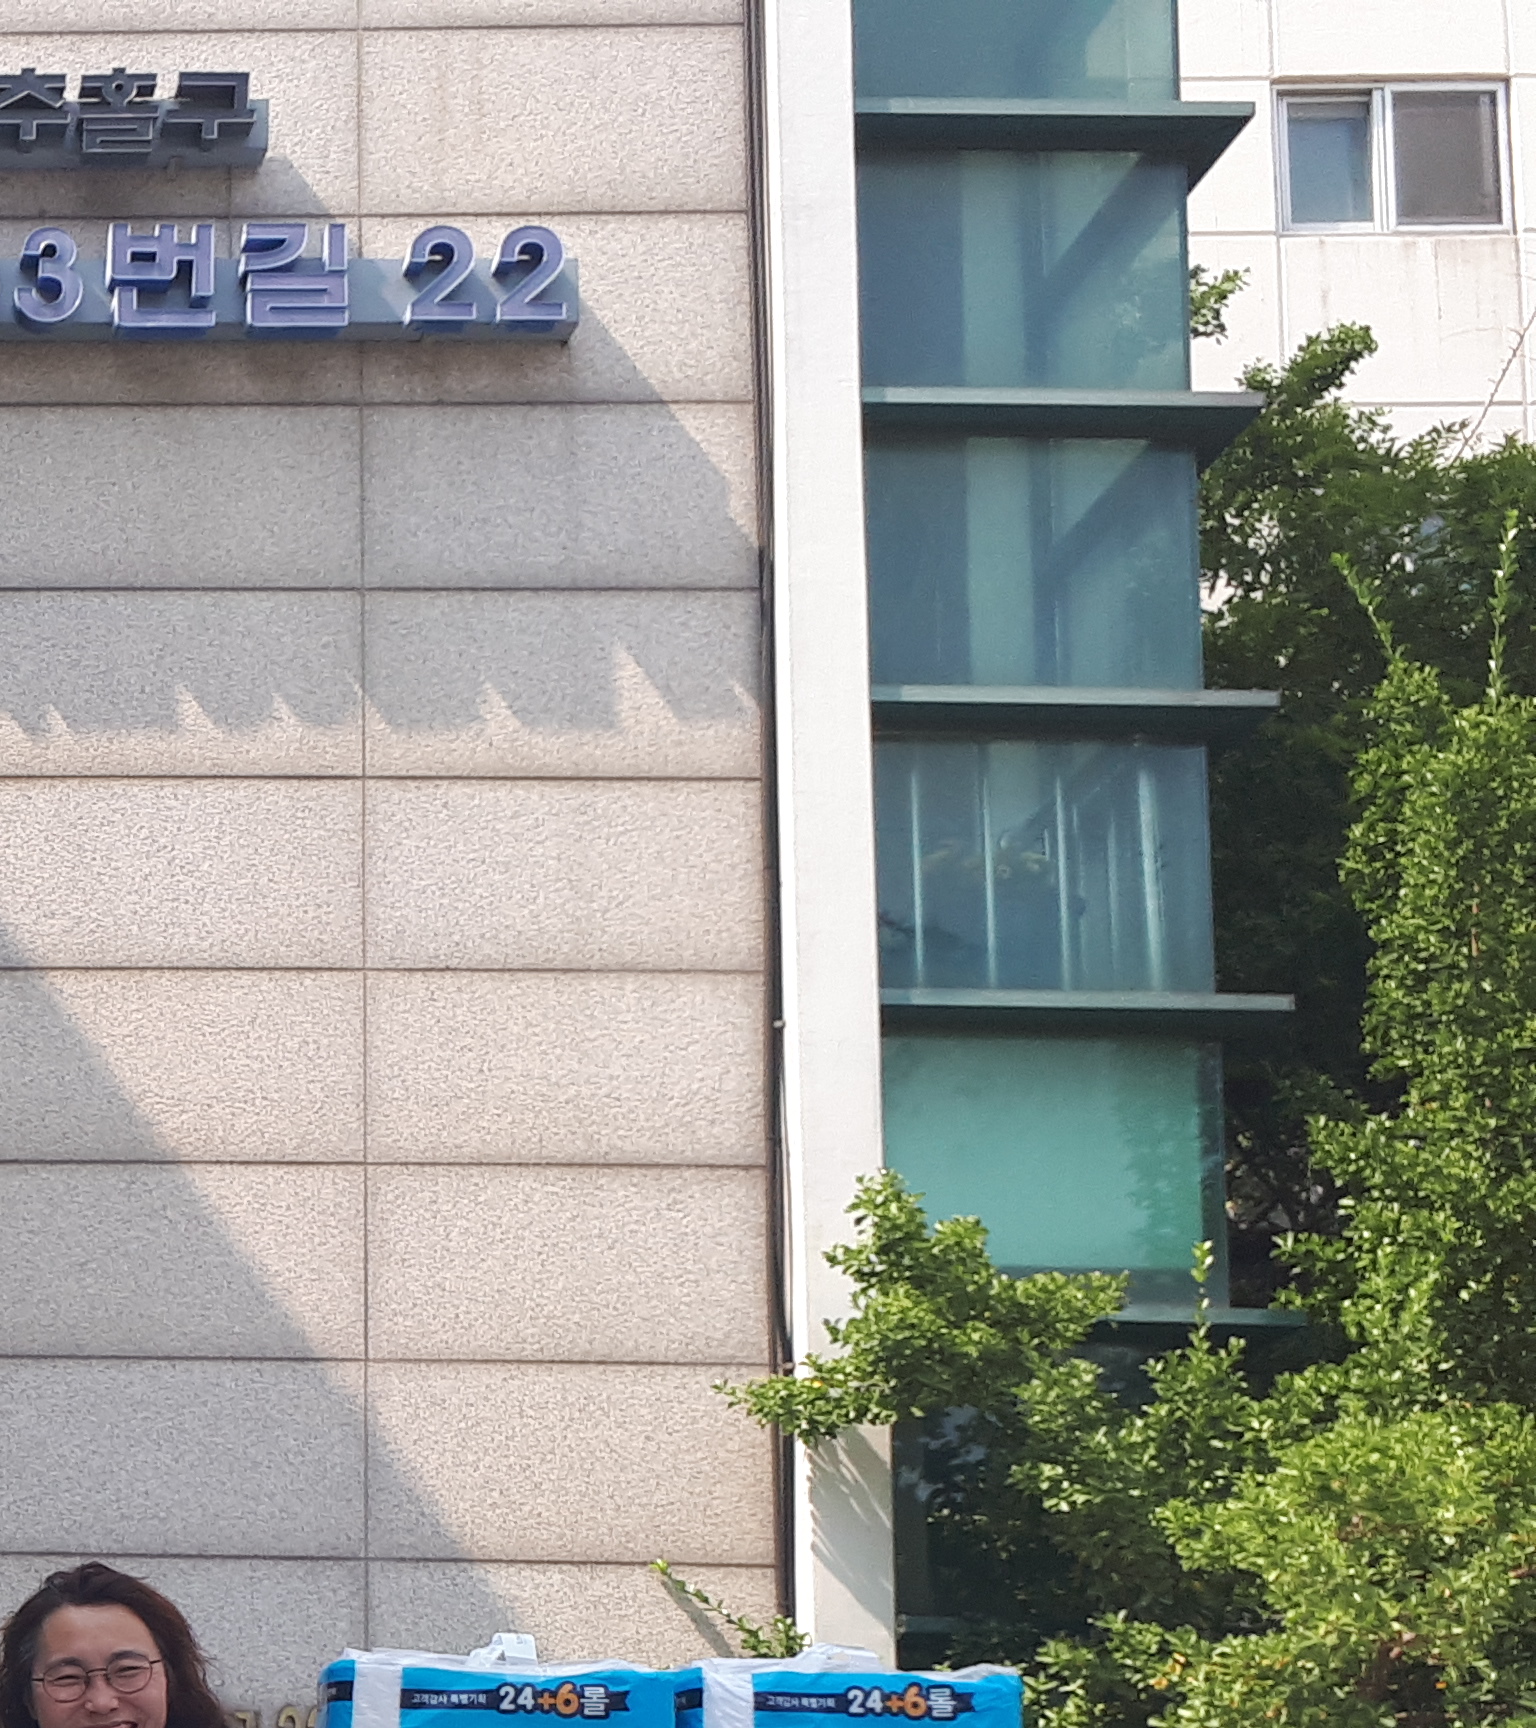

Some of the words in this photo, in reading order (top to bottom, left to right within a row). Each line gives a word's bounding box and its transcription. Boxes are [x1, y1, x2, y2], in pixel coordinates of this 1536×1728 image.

[402, 226, 567, 325] 22
[412, 1693, 448, 1705] 고객감사
[450, 1693, 487, 1705] 특별기획
[498, 1683, 610, 1717] 24+6롤
[846, 1683, 956, 1719] 24+6롤
